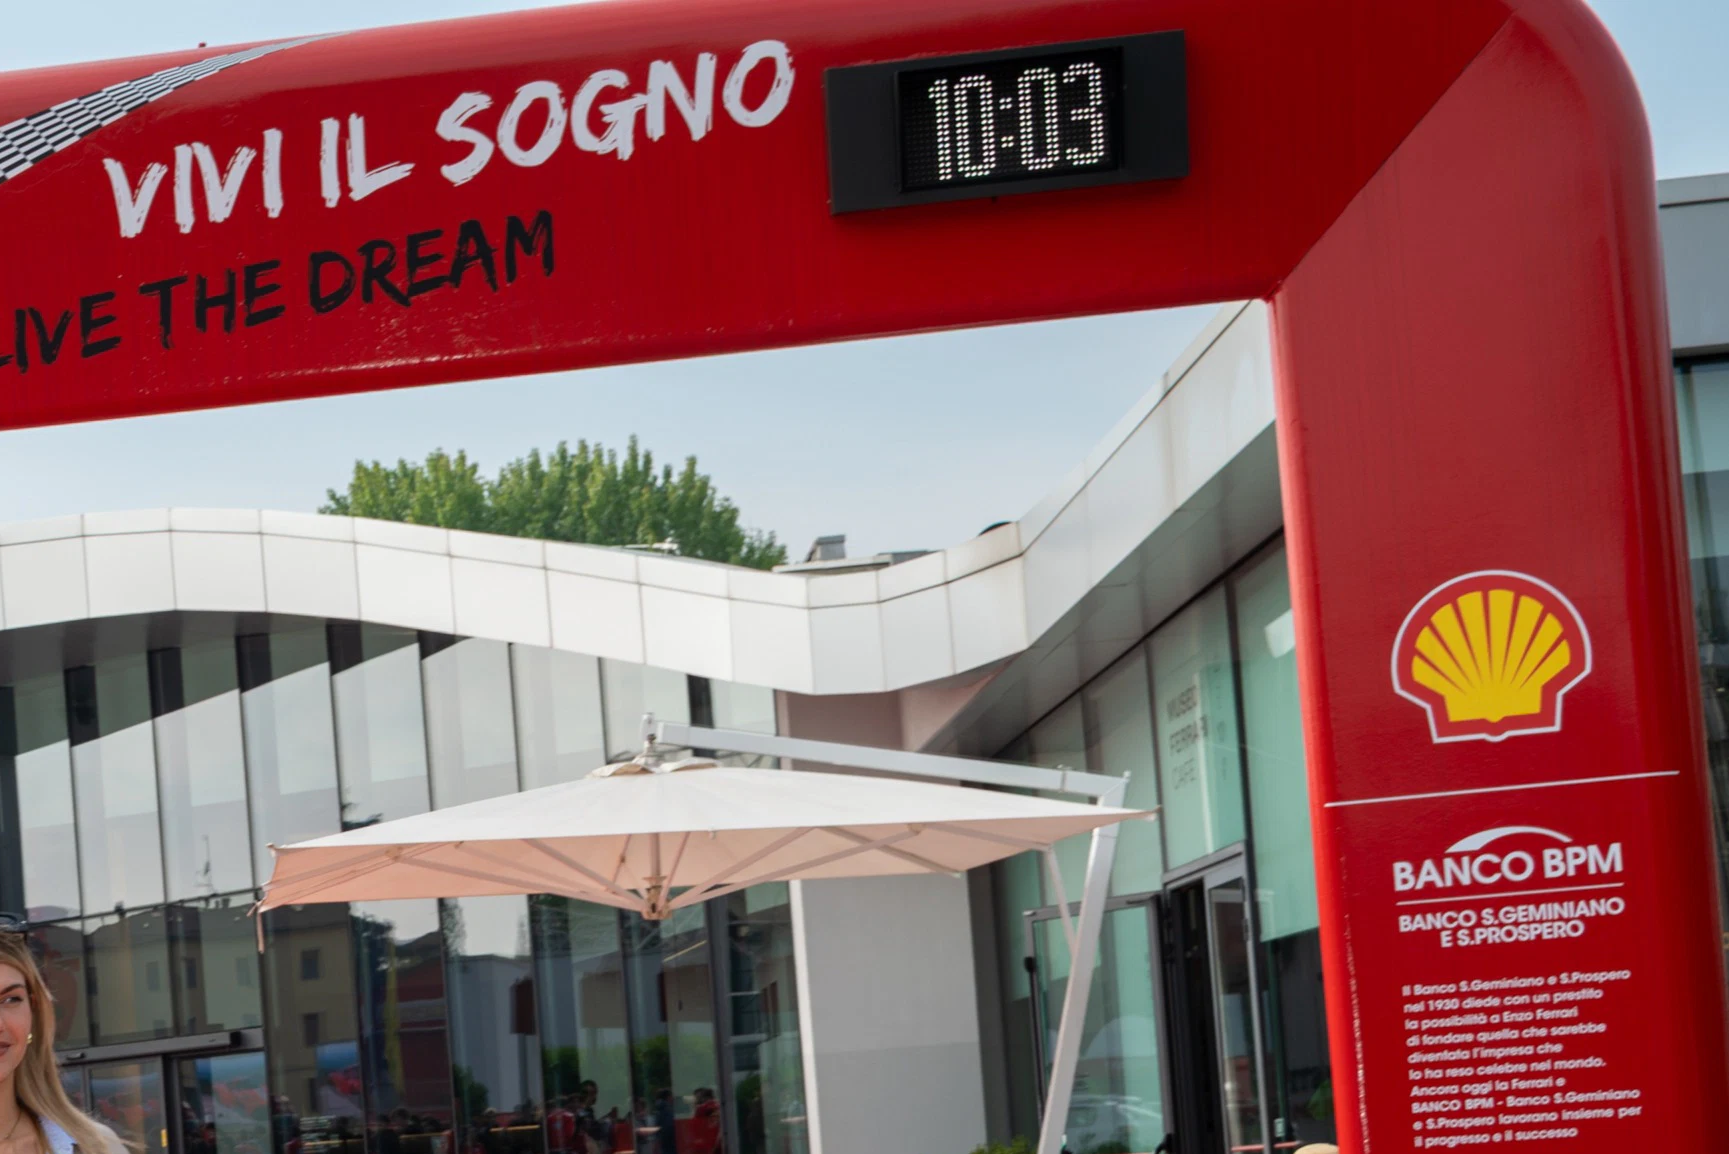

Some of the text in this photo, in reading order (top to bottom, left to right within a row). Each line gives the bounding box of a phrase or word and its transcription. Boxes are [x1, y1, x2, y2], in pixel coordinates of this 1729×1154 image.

[927, 60, 1108, 182] 10:03
[103, 40, 794, 237] VIVI IL SOGNO
[139, 260, 285, 348] THE
[309, 210, 554, 313] DREAM
[1392, 841, 1624, 892] BANCO BPM
[1398, 896, 1626, 933] BANCO S.GEMINIANO
[1439, 918, 1586, 948] E S.PROSPERO
[1401, 984, 1412, 997] Il
[1412, 983, 1458, 996] Banco
[1546, 975, 1558, 986] e
[1403, 987, 1604, 1013] nel 1930 diede con un prestito
[1404, 1018, 1420, 1030] la
[1488, 1013, 1501, 1024] a
[1501, 1010, 1535, 1023] Enzo
[1535, 1005, 1579, 1021] Ferrari
[1405, 1021, 1607, 1047] di fondare quella che sarebbe
[1407, 1048, 1471, 1064] diventata
[1535, 1042, 1564, 1055] che
[1408, 1068, 1424, 1081] lo
[1423, 1067, 1444, 1080] ha
[1444, 1066, 1475, 1078] reso
[1475, 1061, 1529, 1076] celebre
[1529, 1058, 1553, 1072] nel
[1409, 1075, 1566, 1097] Ancora oggi la Ferrari e
[1411, 1098, 1463, 1114] BANCO
[1464, 1096, 1495, 1111] BPM
[1505, 1095, 1551, 1108] Banco
[1412, 1120, 1424, 1131] e
[1497, 1111, 1559, 1125] lavorano
[1561, 1107, 1615, 1121] insieme
[1617, 1106, 1643, 1119] per
[1413, 1127, 1579, 1149] il progresso e il successo
